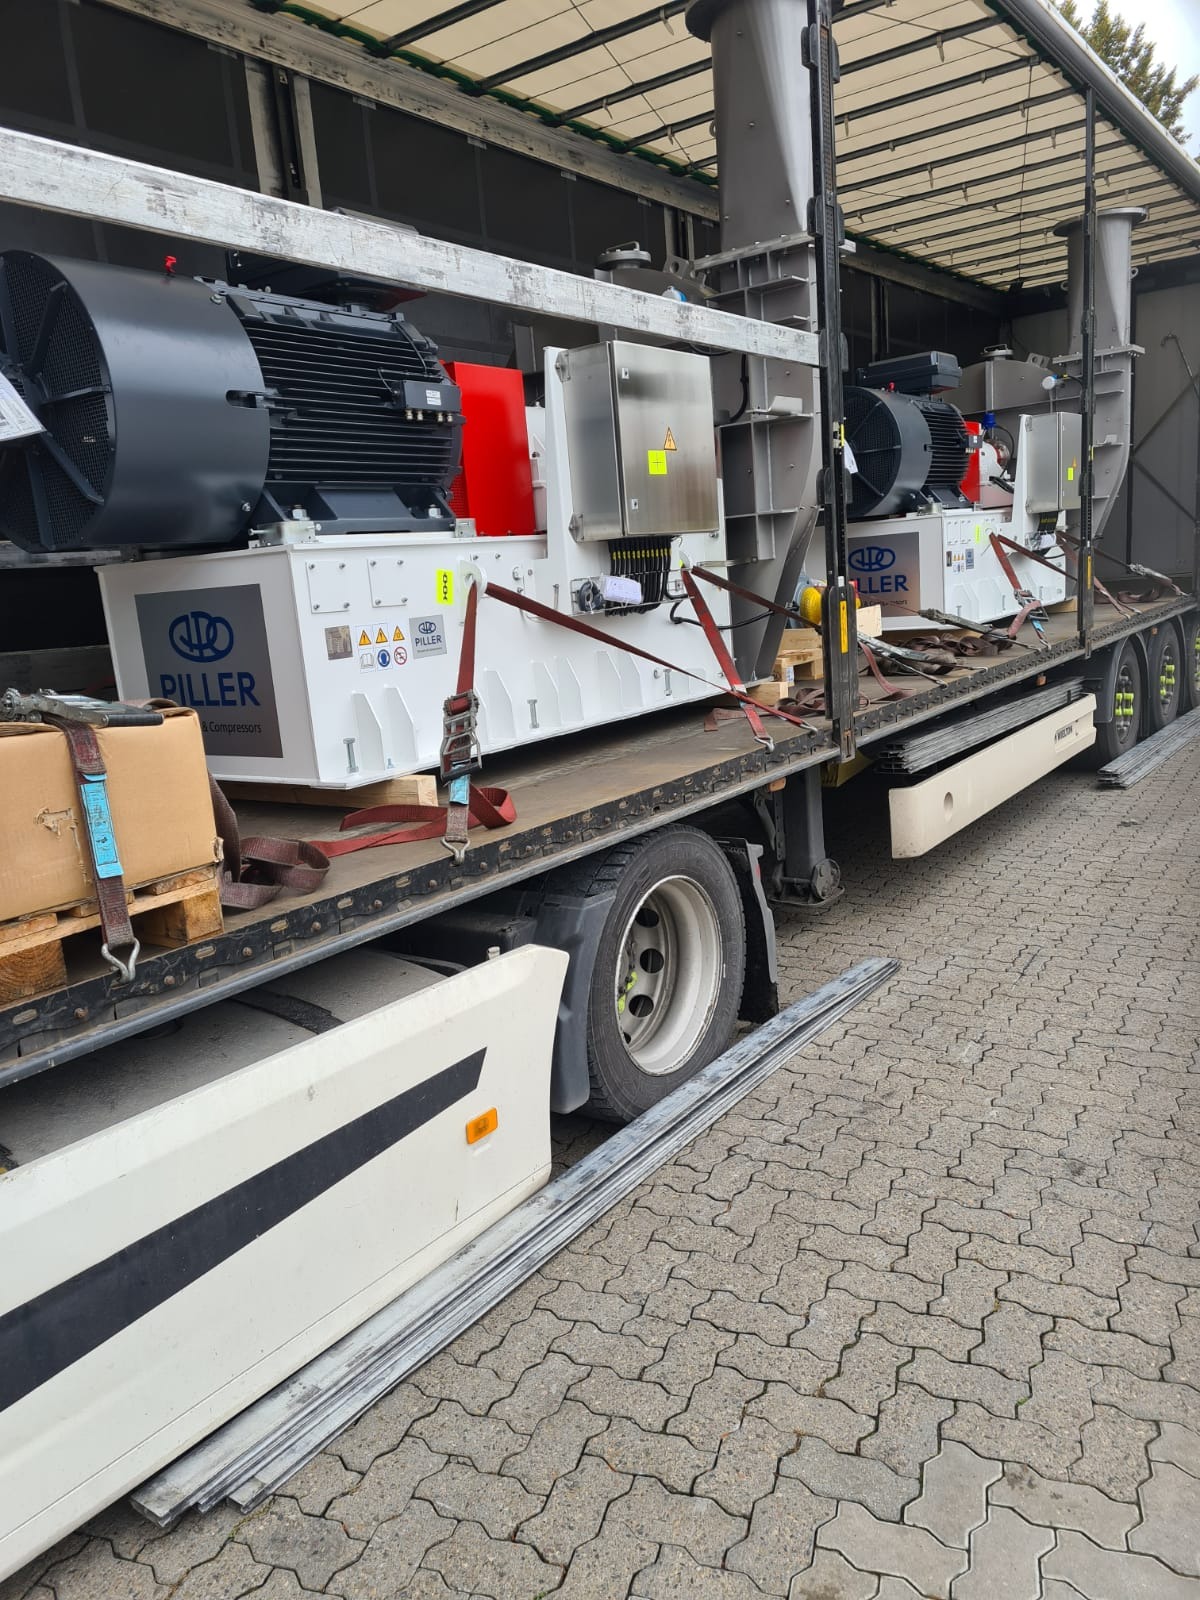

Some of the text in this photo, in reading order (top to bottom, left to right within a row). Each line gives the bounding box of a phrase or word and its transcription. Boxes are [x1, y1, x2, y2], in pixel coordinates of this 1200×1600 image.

[856, 574, 909, 594] LLER
[414, 634, 442, 647] PILLER
[160, 671, 261, 707] PILLER
[209, 720, 262, 735] Compressors
